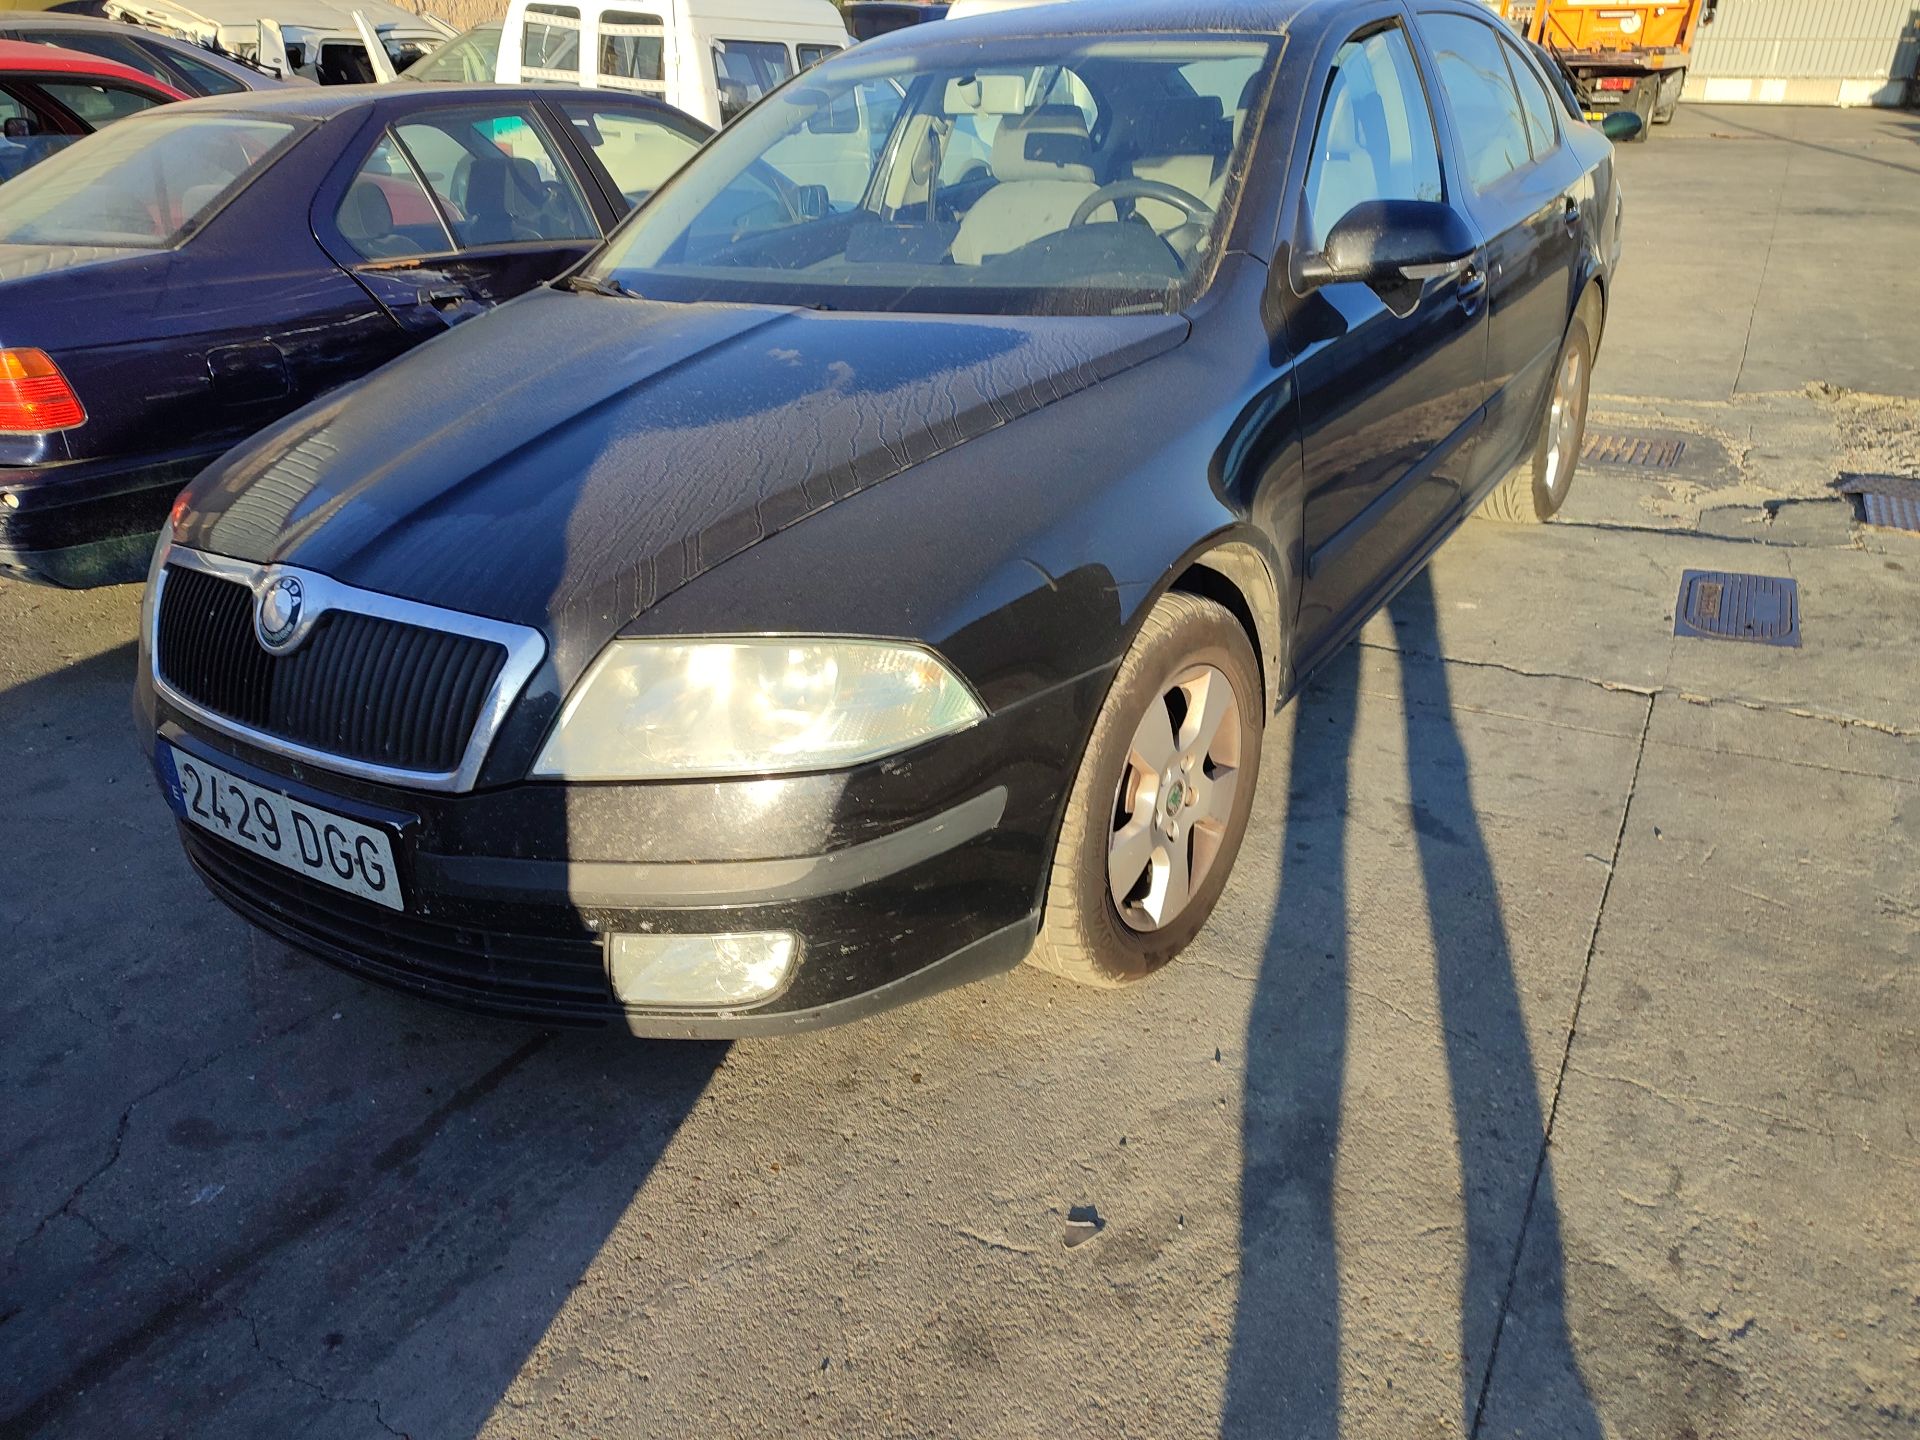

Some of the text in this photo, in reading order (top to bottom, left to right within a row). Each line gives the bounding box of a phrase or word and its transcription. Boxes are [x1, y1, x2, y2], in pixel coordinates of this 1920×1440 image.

[171, 784, 181, 801] E
[183, 763, 386, 892] 2429 DGG
